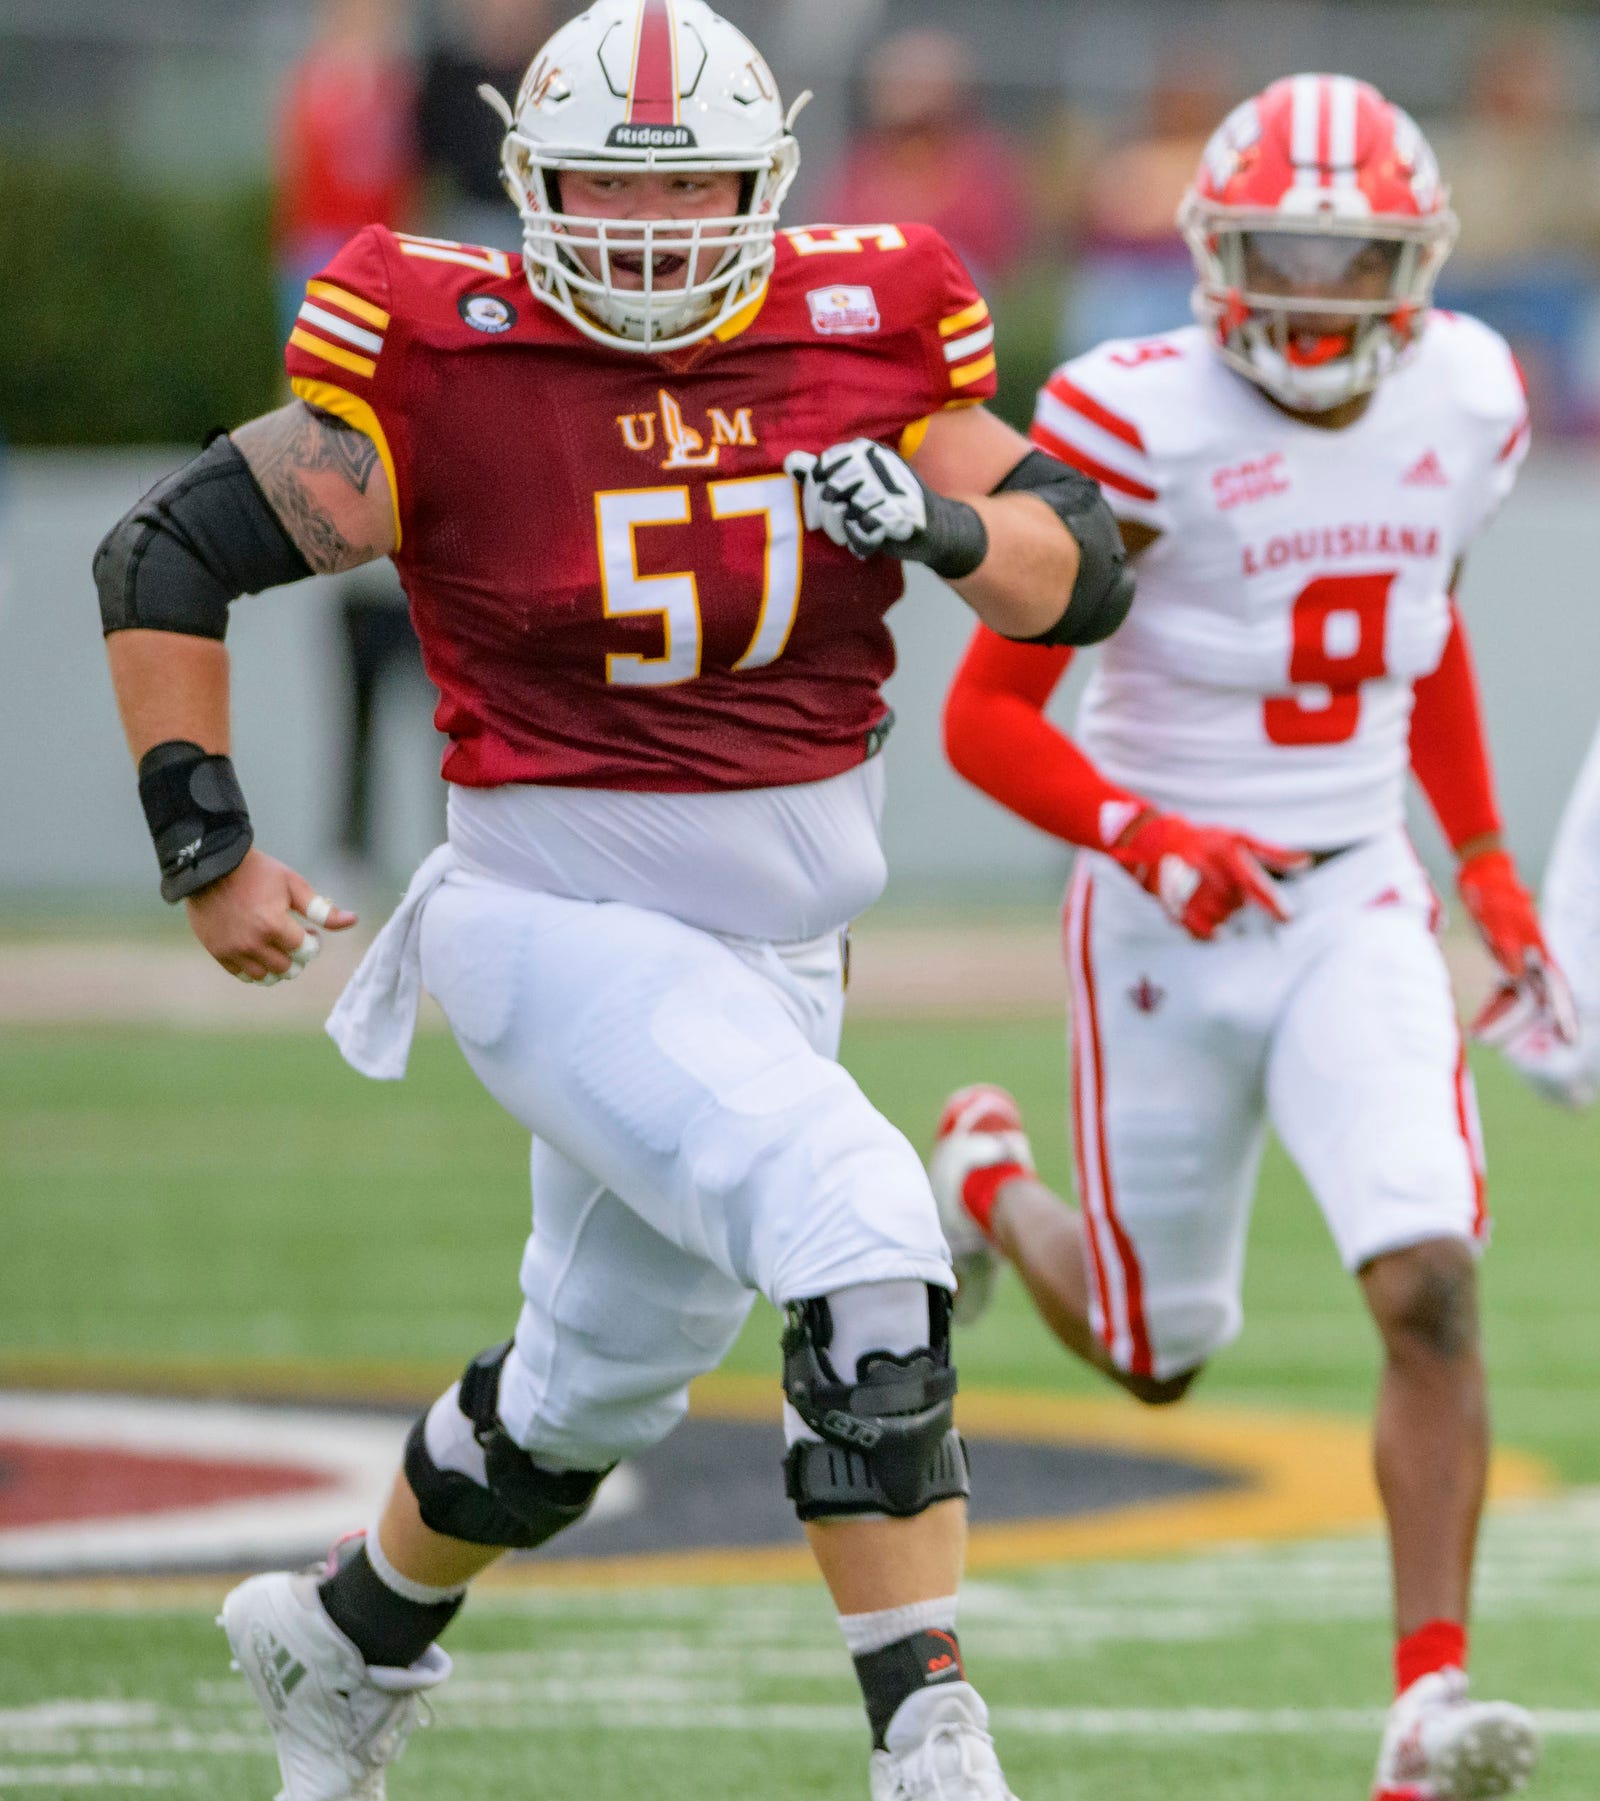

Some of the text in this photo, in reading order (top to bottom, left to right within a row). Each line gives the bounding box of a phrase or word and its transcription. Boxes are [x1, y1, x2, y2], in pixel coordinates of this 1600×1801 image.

[616, 127, 689, 145] Riddell
[616, 388, 758, 470] ULM
[594, 472, 804, 687] 57
[1242, 521, 1440, 577] LOUISIANA
[1262, 569, 1400, 747] 9
